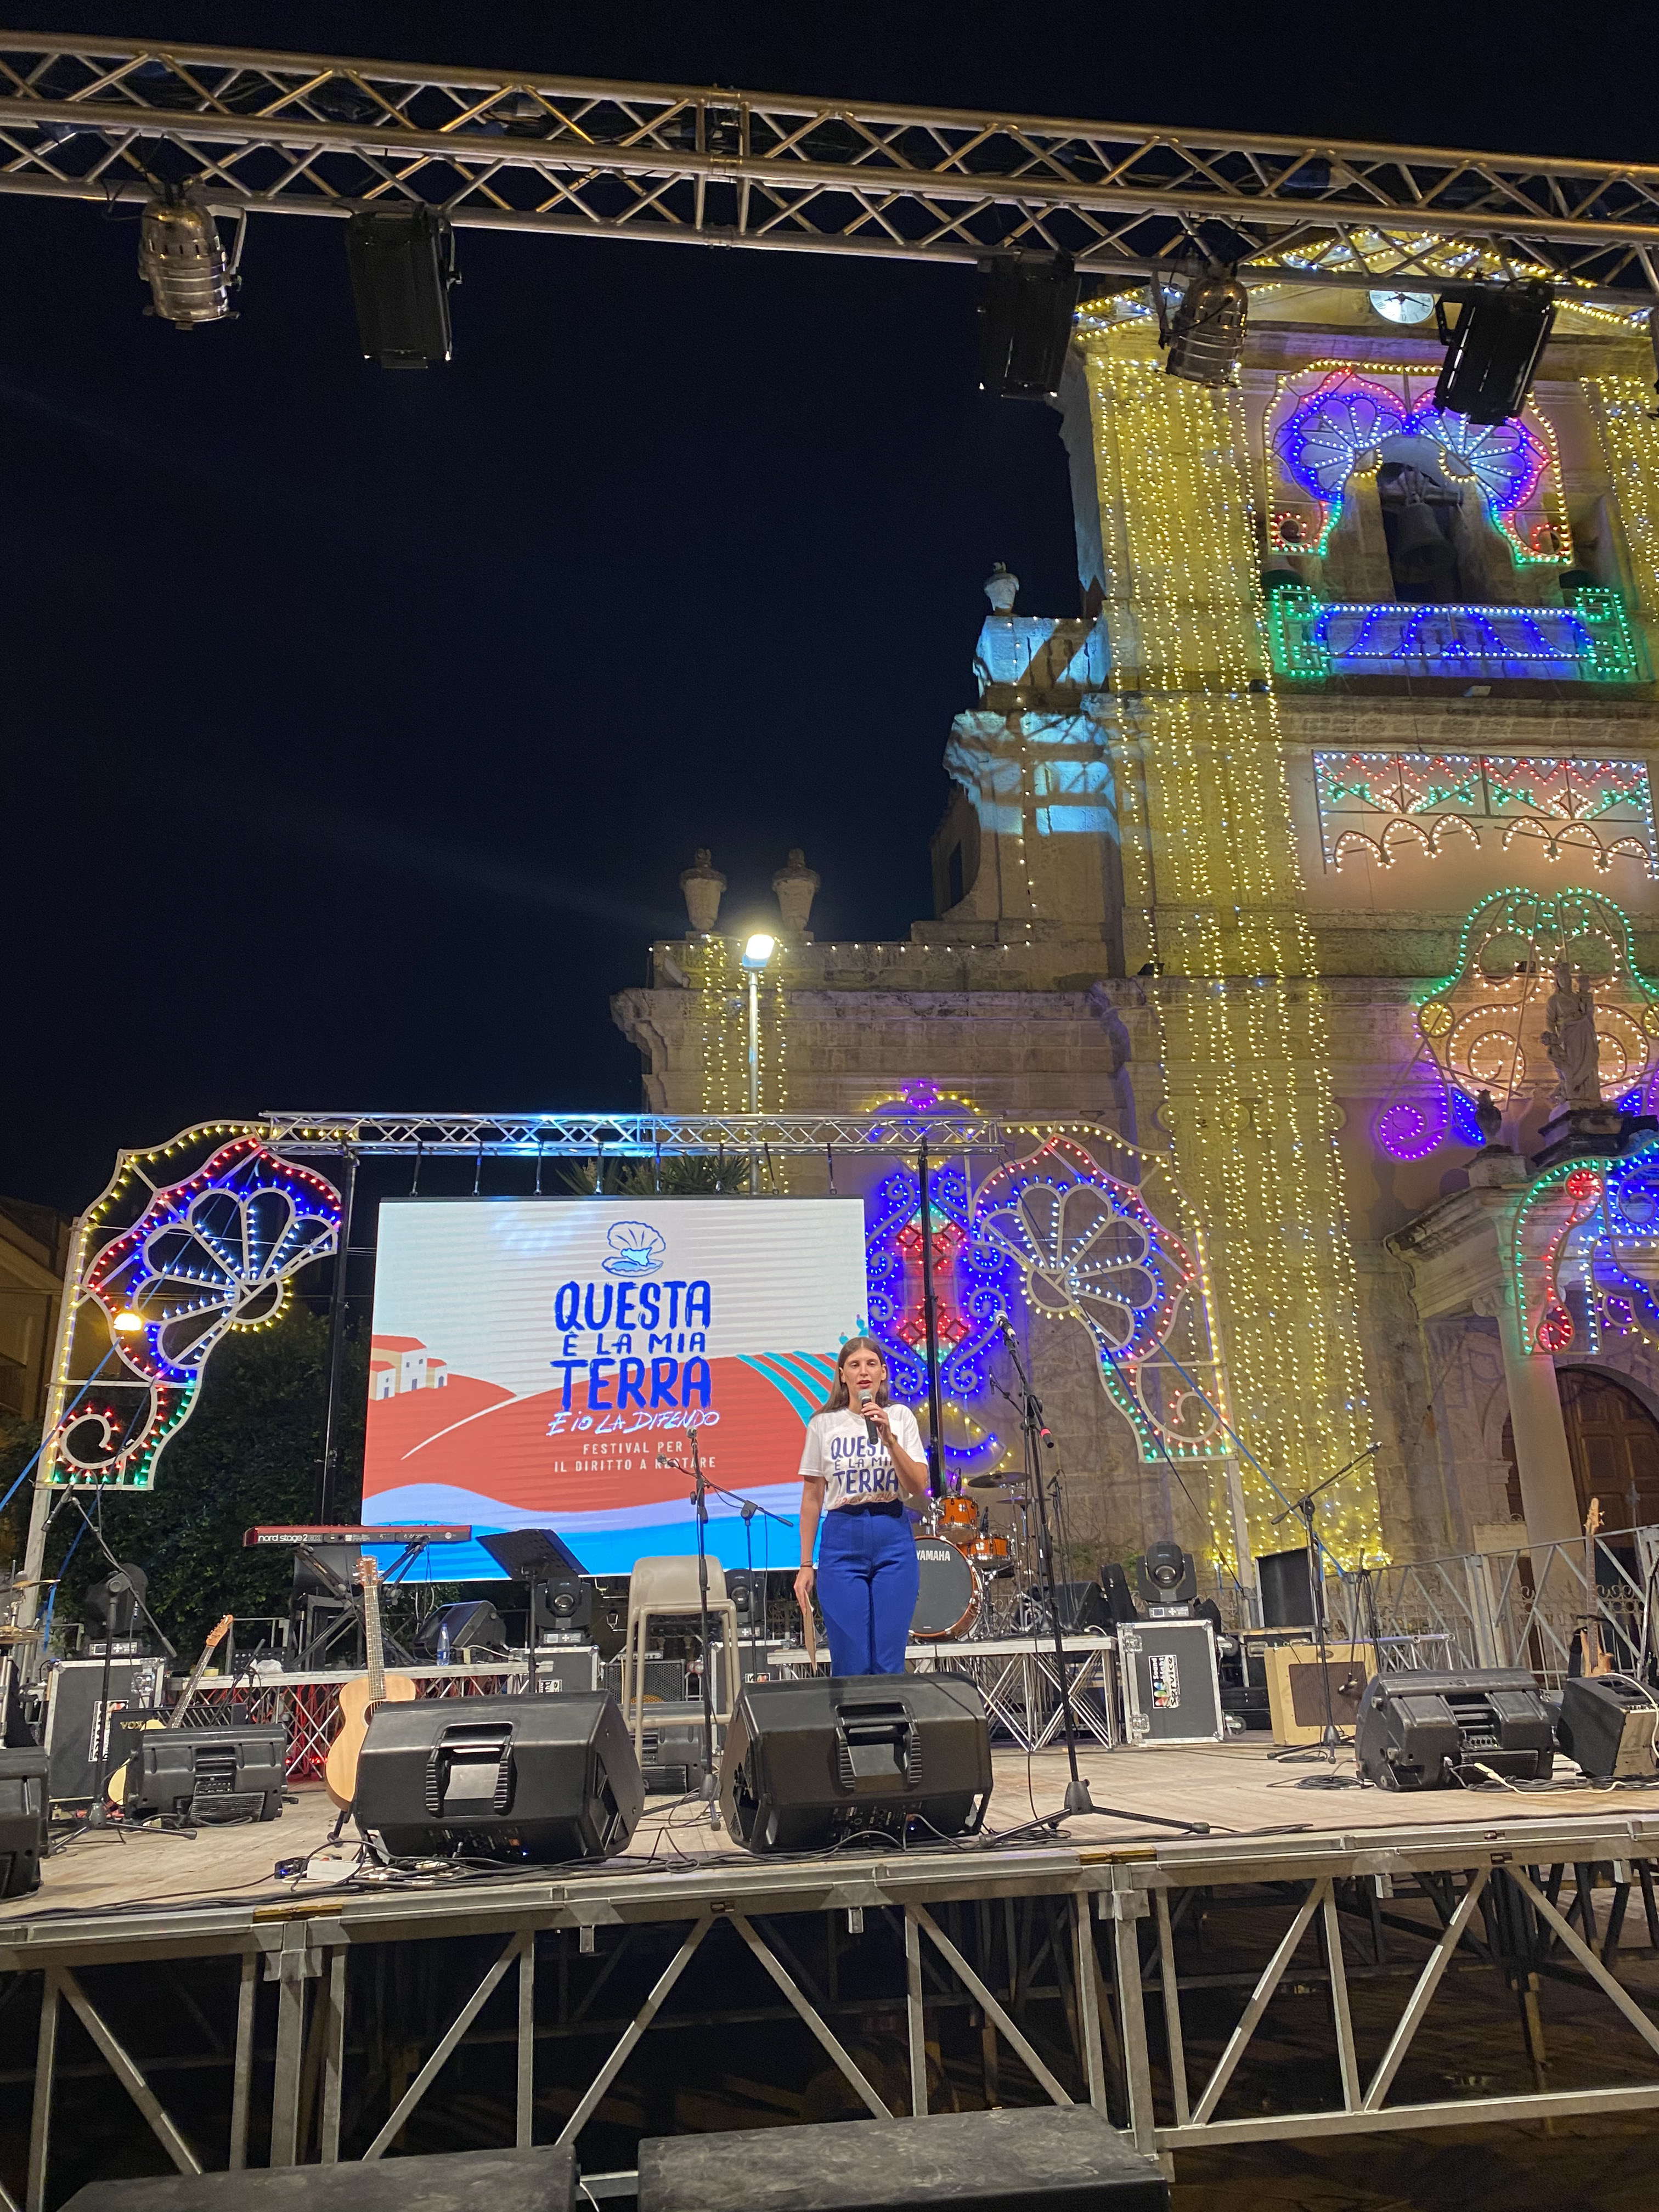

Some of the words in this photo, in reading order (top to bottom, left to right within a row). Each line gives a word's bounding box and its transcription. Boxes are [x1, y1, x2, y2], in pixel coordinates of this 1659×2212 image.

[554, 1280, 710, 1331] QUESTA
[562, 1331, 579, 1356] È
[596, 1333, 631, 1355] LA
[648, 1332, 706, 1354] MIA
[550, 1356, 711, 1411] TERRA
[594, 1413, 627, 1434] LA
[622, 1408, 720, 1434] DIFENDO
[583, 1442, 650, 1455] FESTIVAL
[658, 1441, 683, 1453] PER
[554, 1462, 567, 1472] IL
[575, 1459, 632, 1471] DIRITTO
[640, 1459, 647, 1470] A
[849, 1458, 865, 1468] LA
[872, 1457, 892, 1467] MI
[832, 1468, 899, 1494] TERRA
[916, 1550, 951, 1561] YAMAHA
[1151, 1657, 1159, 1680] Sound
[1168, 1657, 1177, 1706] Service
[120, 1720, 144, 1730] VOX
